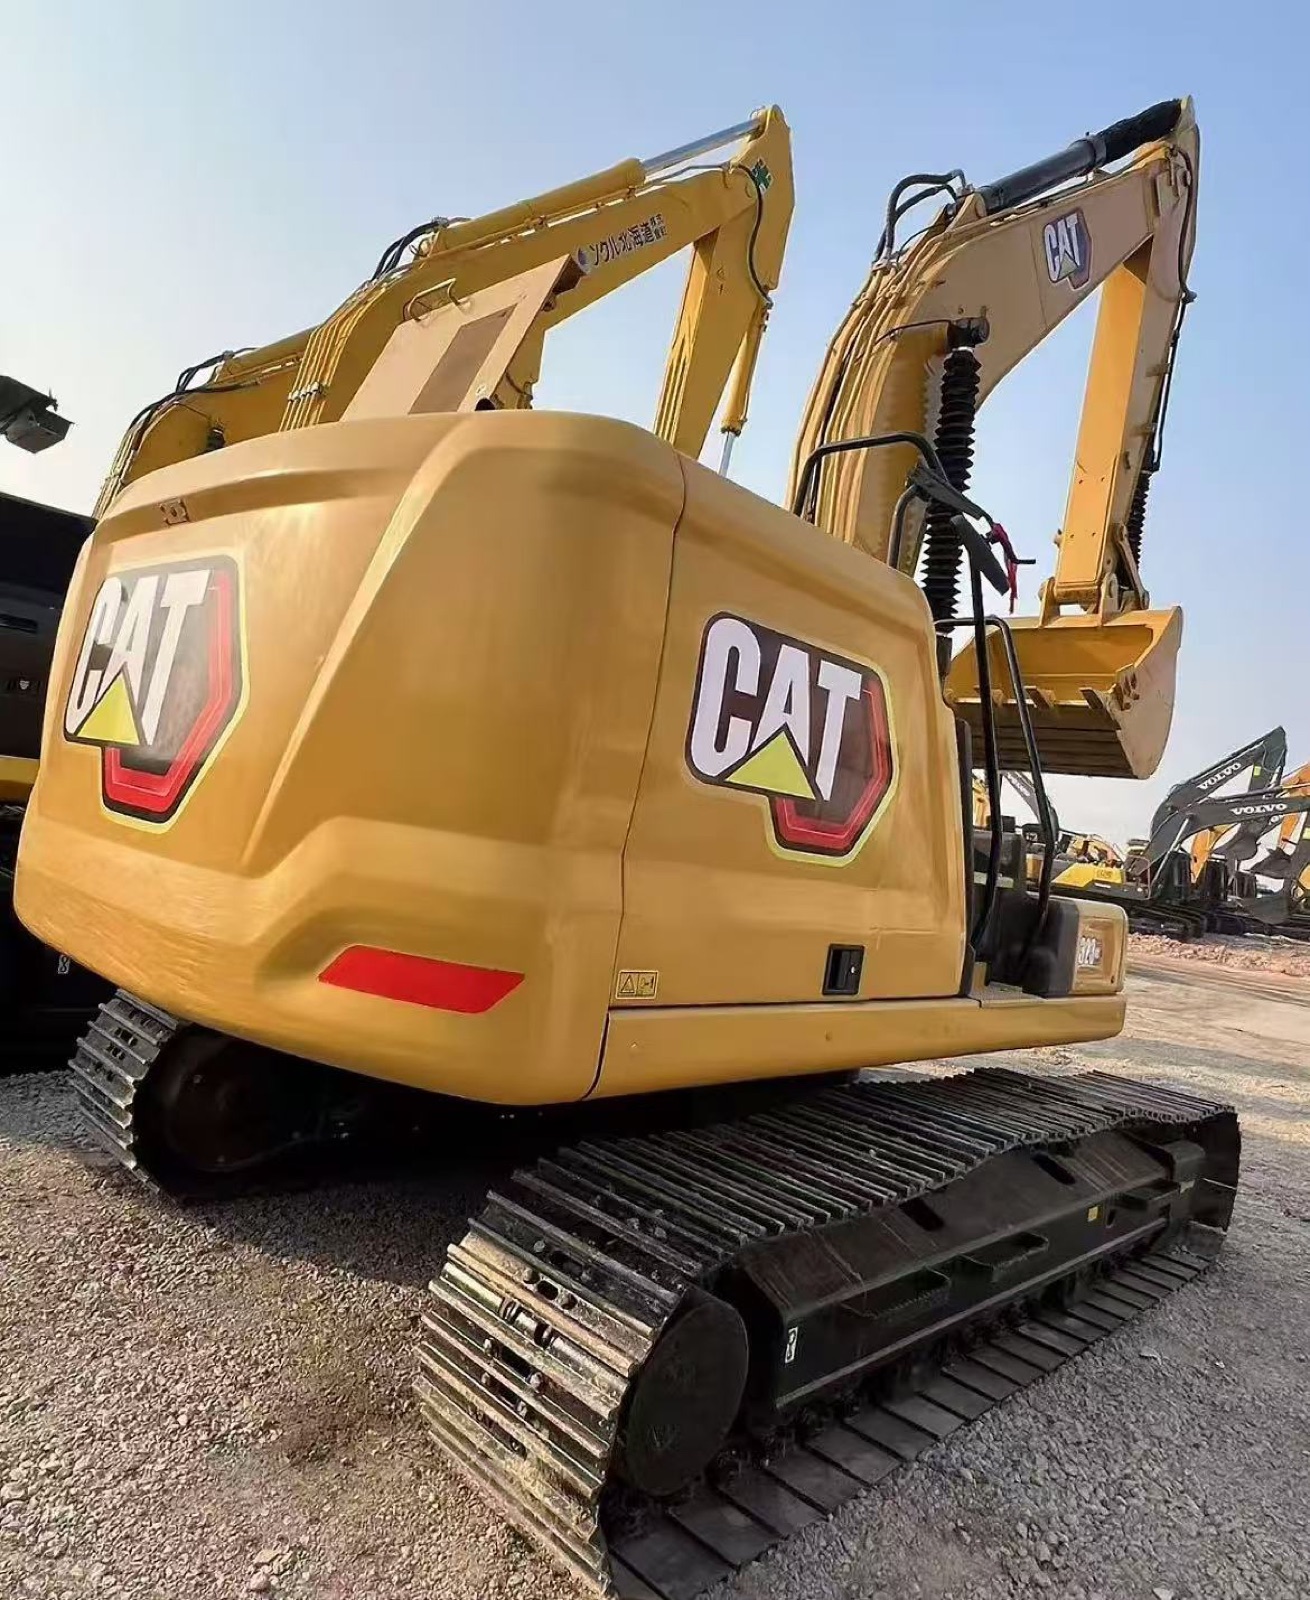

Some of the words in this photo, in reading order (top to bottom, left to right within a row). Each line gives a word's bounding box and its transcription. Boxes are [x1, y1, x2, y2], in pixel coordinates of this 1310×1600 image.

[1044, 213, 1080, 281] CAT
[66, 569, 210, 745] CAT
[691, 618, 862, 800] CAT
[1196, 762, 1241, 790] VOLVO
[1229, 803, 1287, 815] VOLVO
